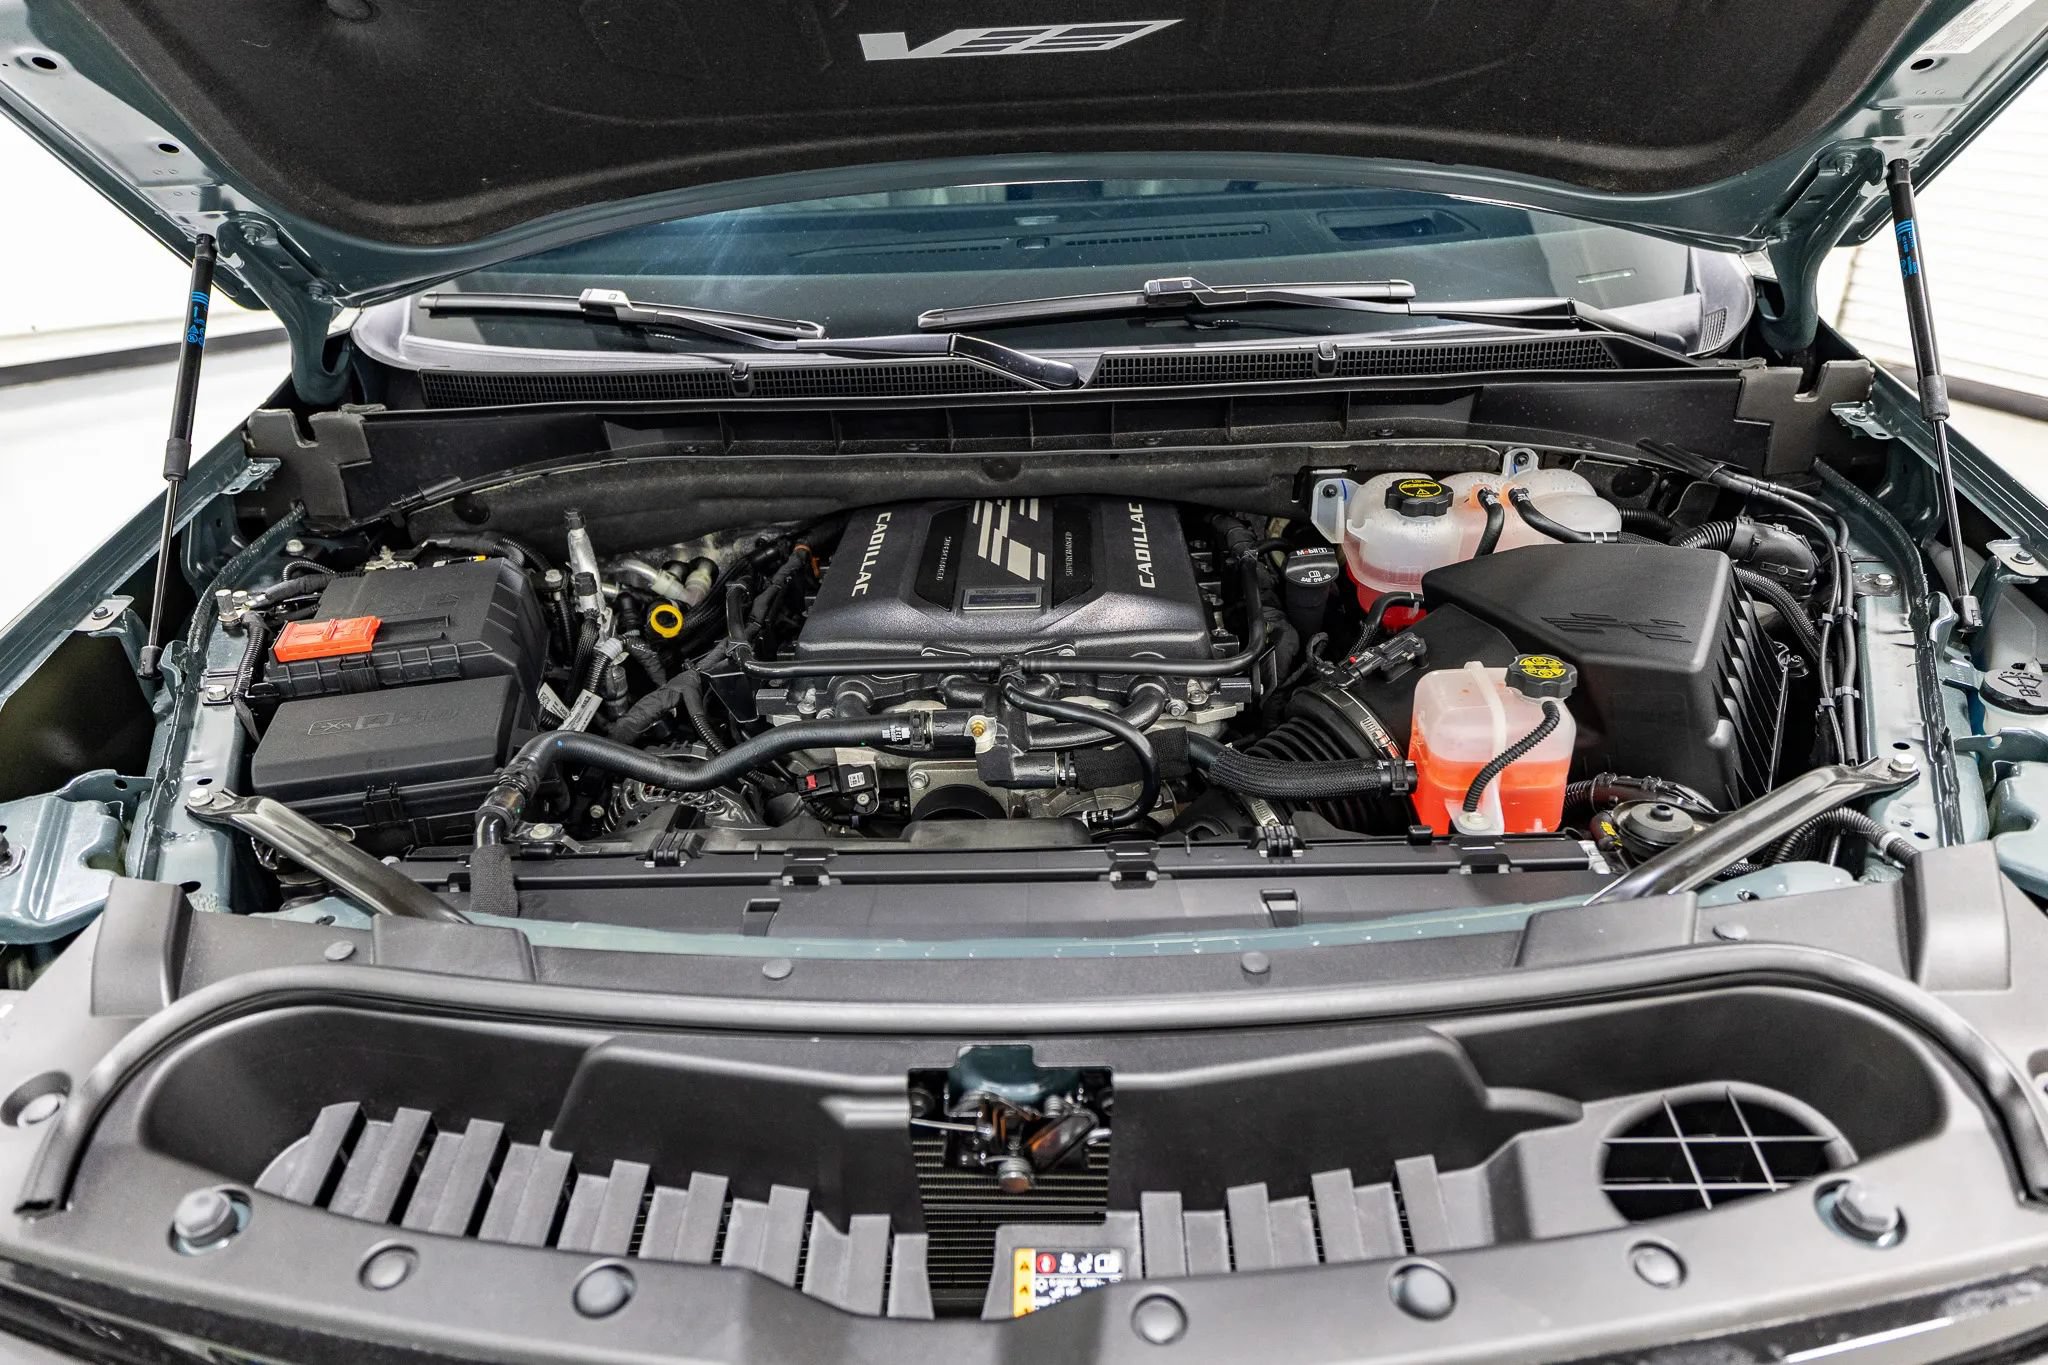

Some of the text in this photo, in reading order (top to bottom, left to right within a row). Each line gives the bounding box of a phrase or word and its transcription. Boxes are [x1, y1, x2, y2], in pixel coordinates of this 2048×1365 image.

[851, 512, 892, 597] CADILLAC
[1128, 502, 1156, 588] CADILLAC
[1296, 548, 1318, 556] Mobil
